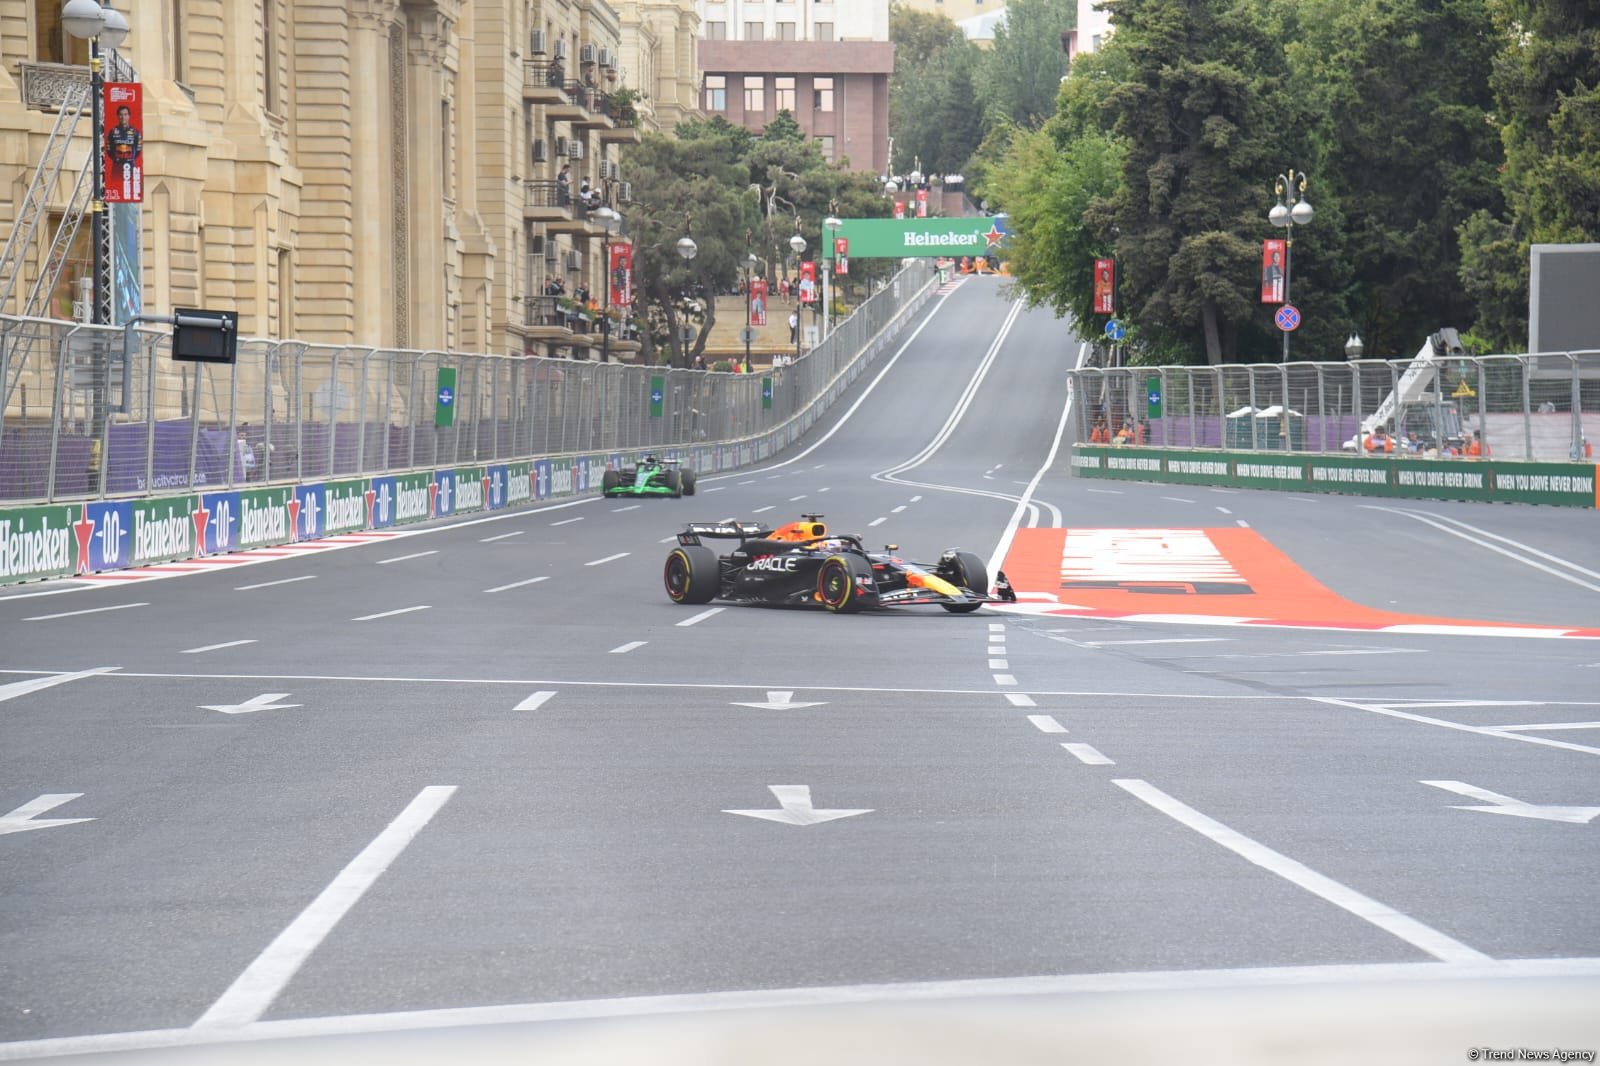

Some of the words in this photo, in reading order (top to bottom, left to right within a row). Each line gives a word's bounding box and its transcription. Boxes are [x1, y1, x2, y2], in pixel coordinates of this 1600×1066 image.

[903, 231, 978, 246] Heineken
[1236, 463, 1250, 477] WHEN
[1250, 464, 1260, 477] YOU
[1260, 465, 1274, 478] DRIVE
[1274, 465, 1287, 479] NEVER
[1287, 466, 1302, 480] DRINK
[1313, 467, 1327, 481] WHEN
[1327, 468, 1338, 481] YOU
[1338, 468, 1353, 482] DRIVE
[1353, 469, 1369, 483] NEVER
[1370, 470, 1387, 484] DRINK
[1399, 471, 1414, 485] WHEN
[1415, 471, 1426, 486] YOU
[1427, 472, 1444, 486] DRIVE
[1444, 473, 1463, 488] NEVER
[1464, 473, 1483, 489] DRINK
[1496, 474, 1515, 490] WHEN
[1515, 475, 1529, 490] YOU
[1530, 475, 1548, 491] DRIVE
[1550, 476, 1571, 492] NEVER
[1572, 477, 1592, 493] DRINK
[325, 487, 364, 531] Heineken
[396, 480, 428, 520] Heineken
[241, 496, 286, 544] Heineken
[135, 507, 190, 560] Heineken
[215, 501, 229, 548] 0.0
[0, 516, 70, 577] Heineken
[103, 510, 120, 564] 0.0
[746, 558, 798, 572] ORACLE
